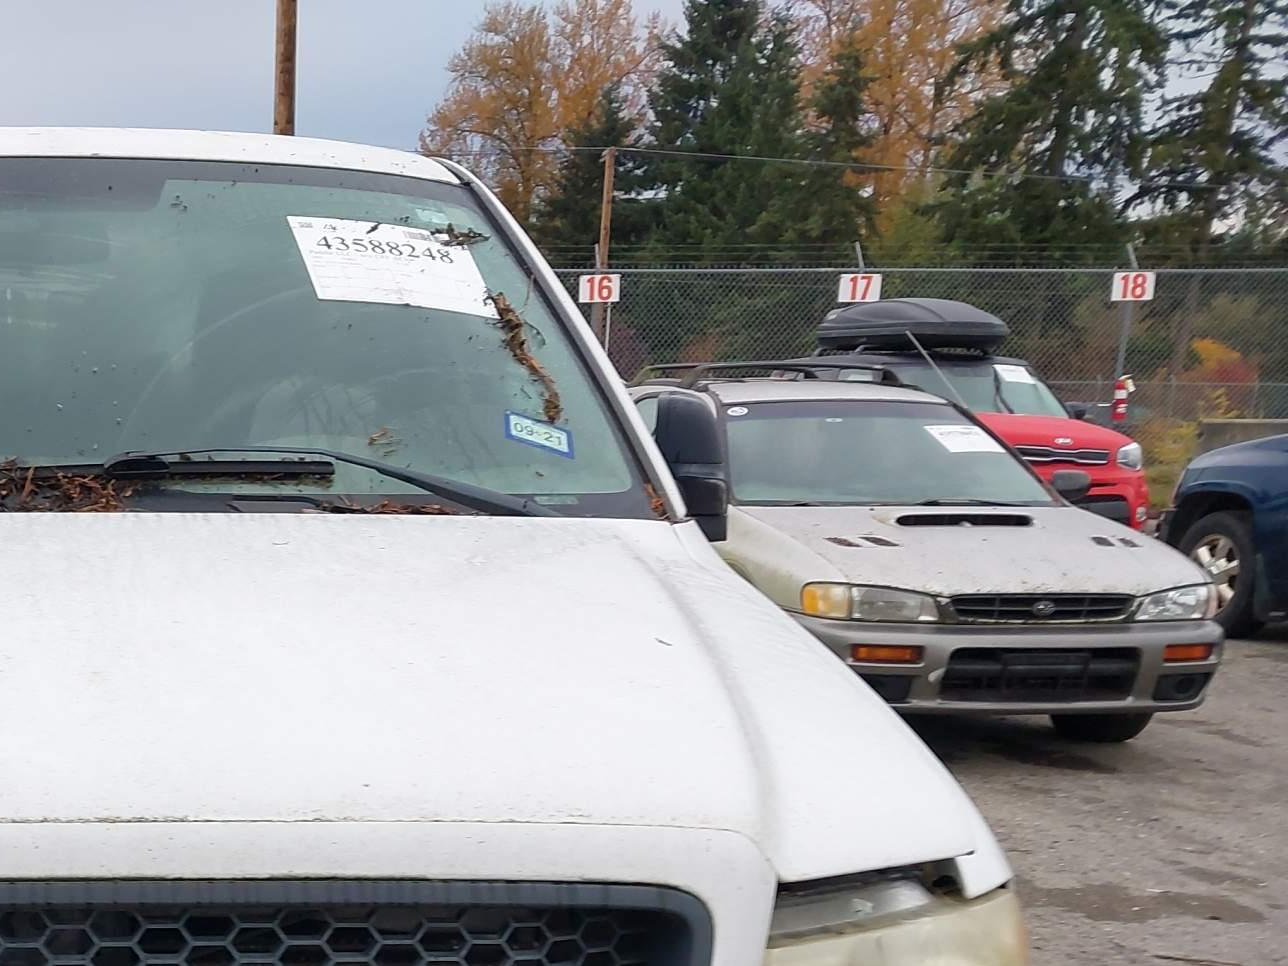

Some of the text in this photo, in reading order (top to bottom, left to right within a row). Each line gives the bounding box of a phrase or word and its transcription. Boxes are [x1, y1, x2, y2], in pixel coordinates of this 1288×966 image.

[317, 234, 455, 265] 43588248
[586, 275, 613, 301] 16
[849, 275, 873, 301] 17
[1120, 273, 1148, 299] 18
